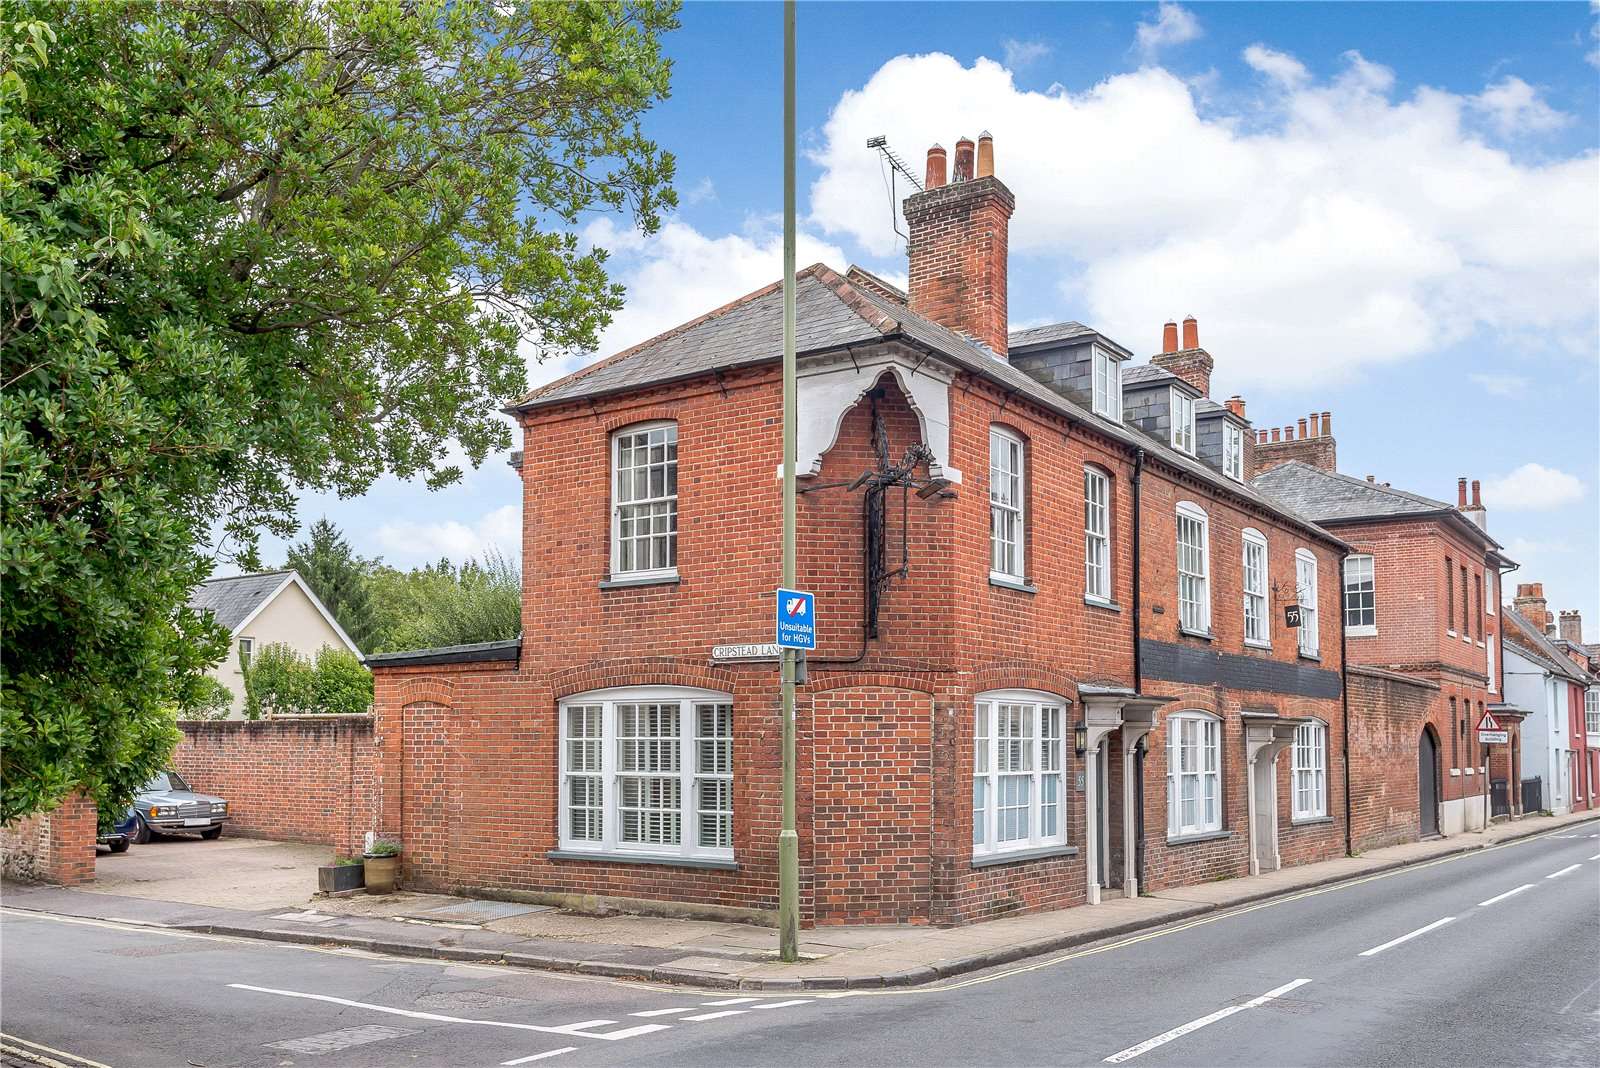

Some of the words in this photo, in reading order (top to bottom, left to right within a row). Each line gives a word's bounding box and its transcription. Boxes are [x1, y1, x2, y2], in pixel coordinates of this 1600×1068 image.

[1287, 611, 1299, 623] 55
[780, 621, 812, 633] Unsuitable
[782, 633, 791, 642] for
[793, 634, 811, 643] HGVs
[713, 646, 758, 657] CRIPSTEAD
